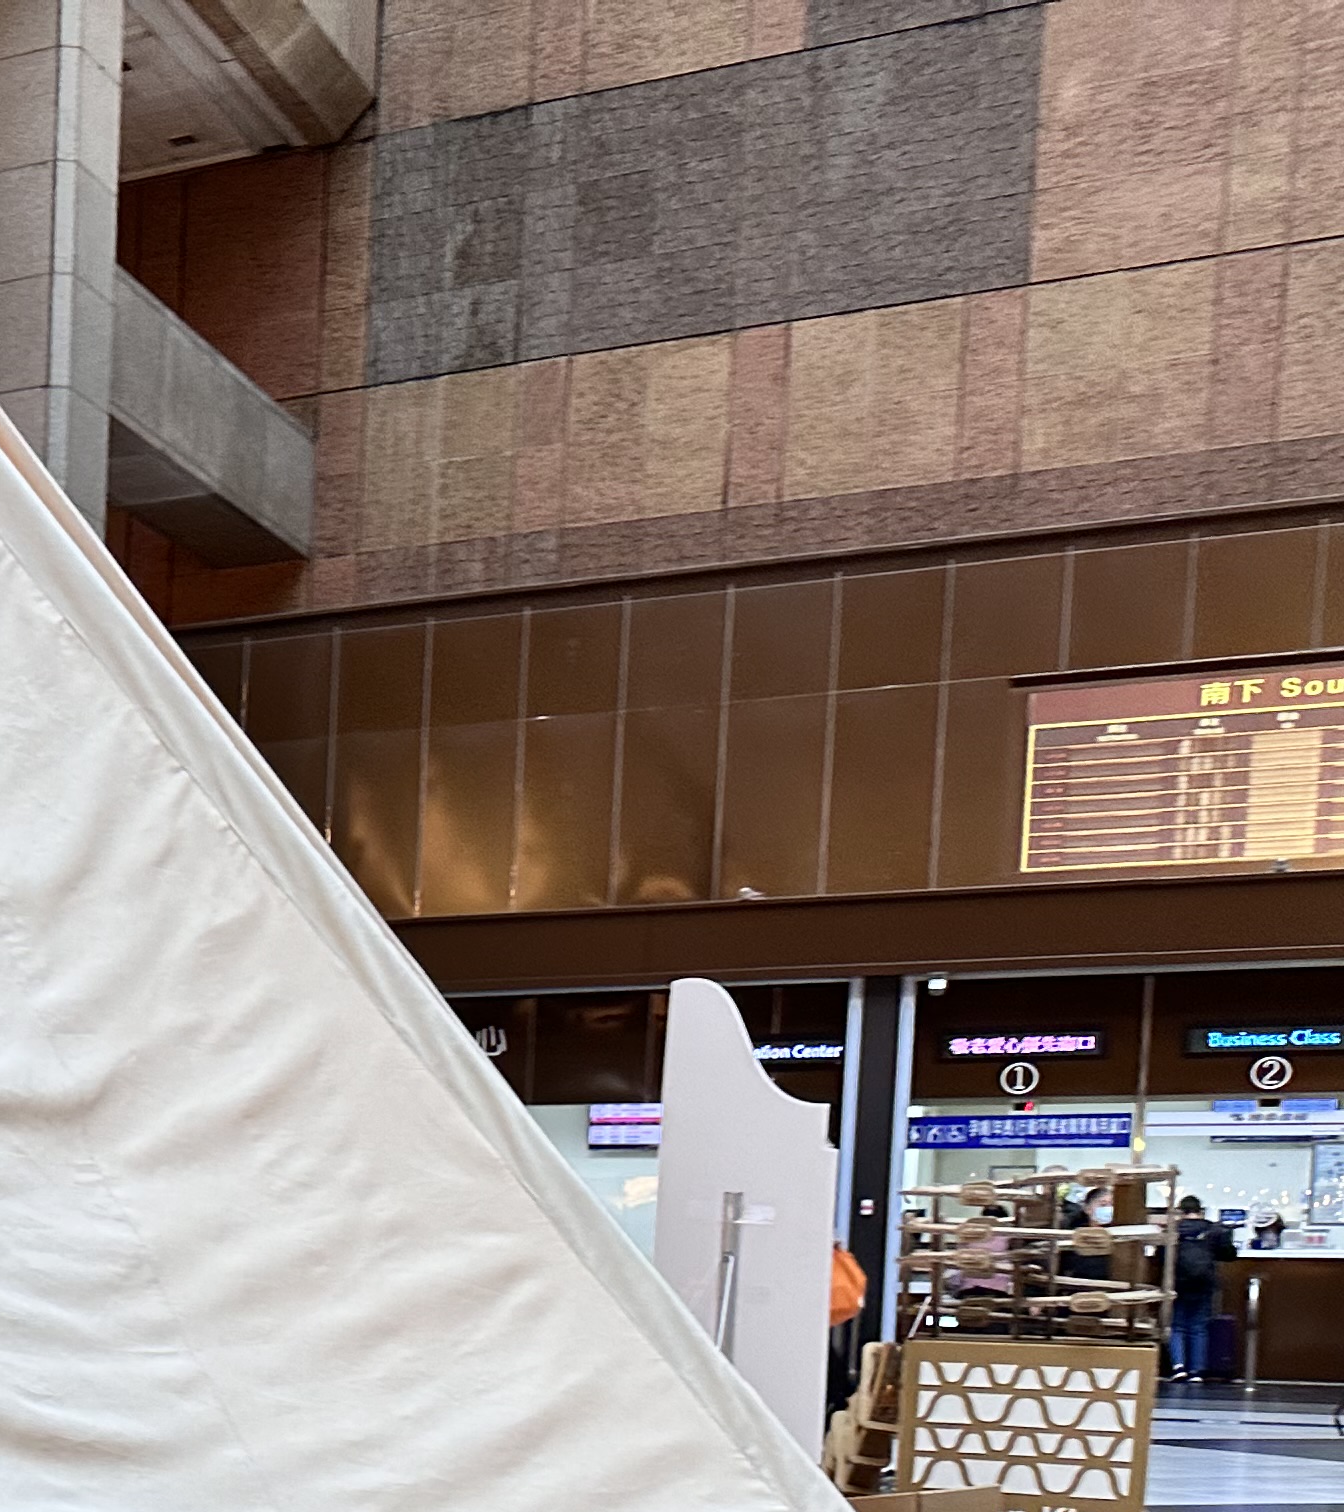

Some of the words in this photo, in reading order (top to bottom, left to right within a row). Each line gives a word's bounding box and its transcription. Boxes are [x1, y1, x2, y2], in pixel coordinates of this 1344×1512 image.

[1199, 678, 1265, 707] 南下
[1207, 1031, 1288, 1048] Business
[1289, 1028, 1341, 1045] Class
[791, 1043, 843, 1058] Center
